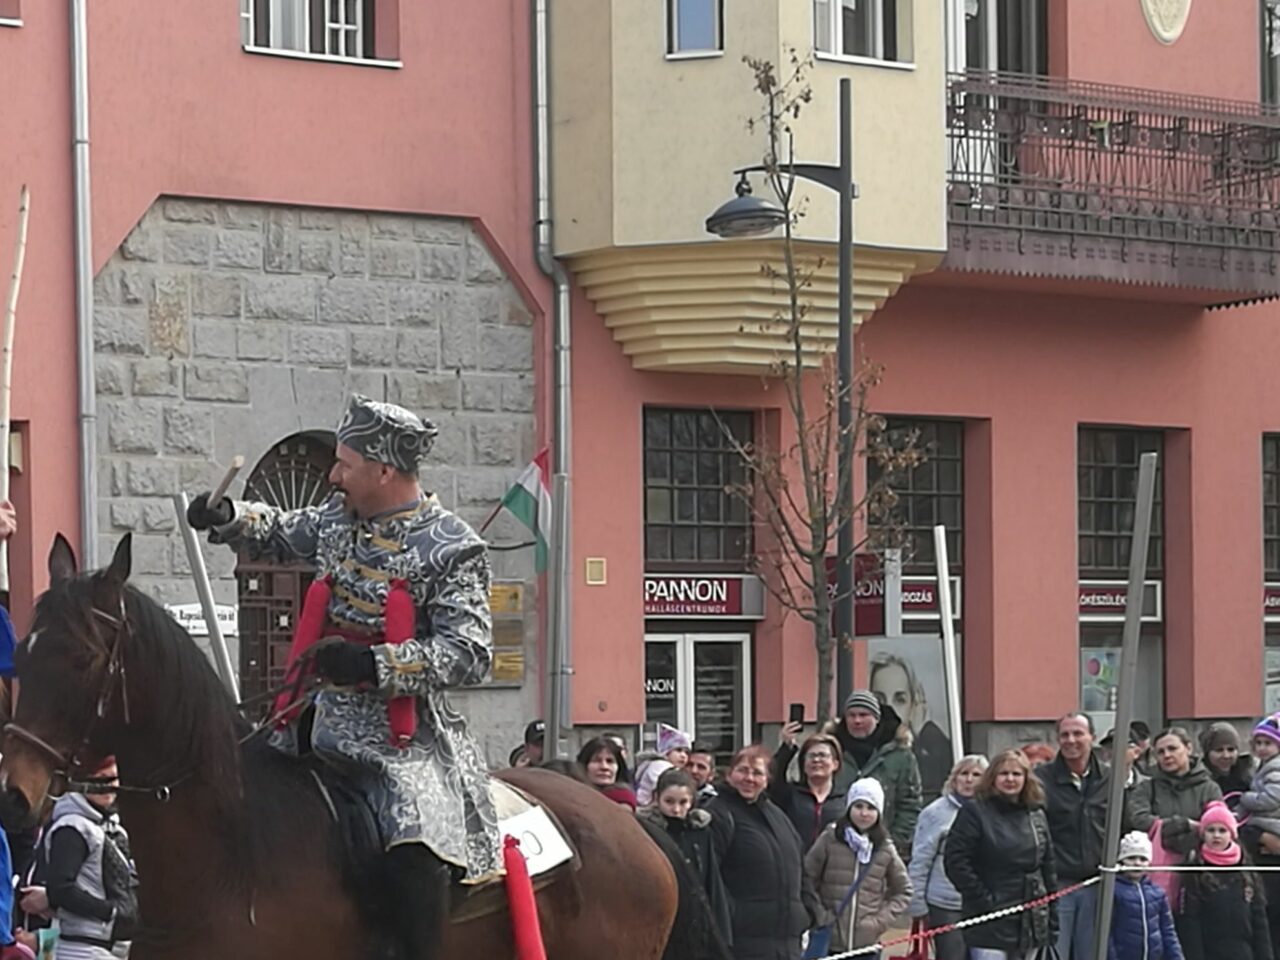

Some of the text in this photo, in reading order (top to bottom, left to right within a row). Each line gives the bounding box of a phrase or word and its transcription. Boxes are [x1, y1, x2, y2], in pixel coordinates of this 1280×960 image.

[645, 579, 727, 602] PANNON
[900, 589, 933, 604] DOZÁS
[645, 603, 727, 613] HALLÁSCENTRUMOK
